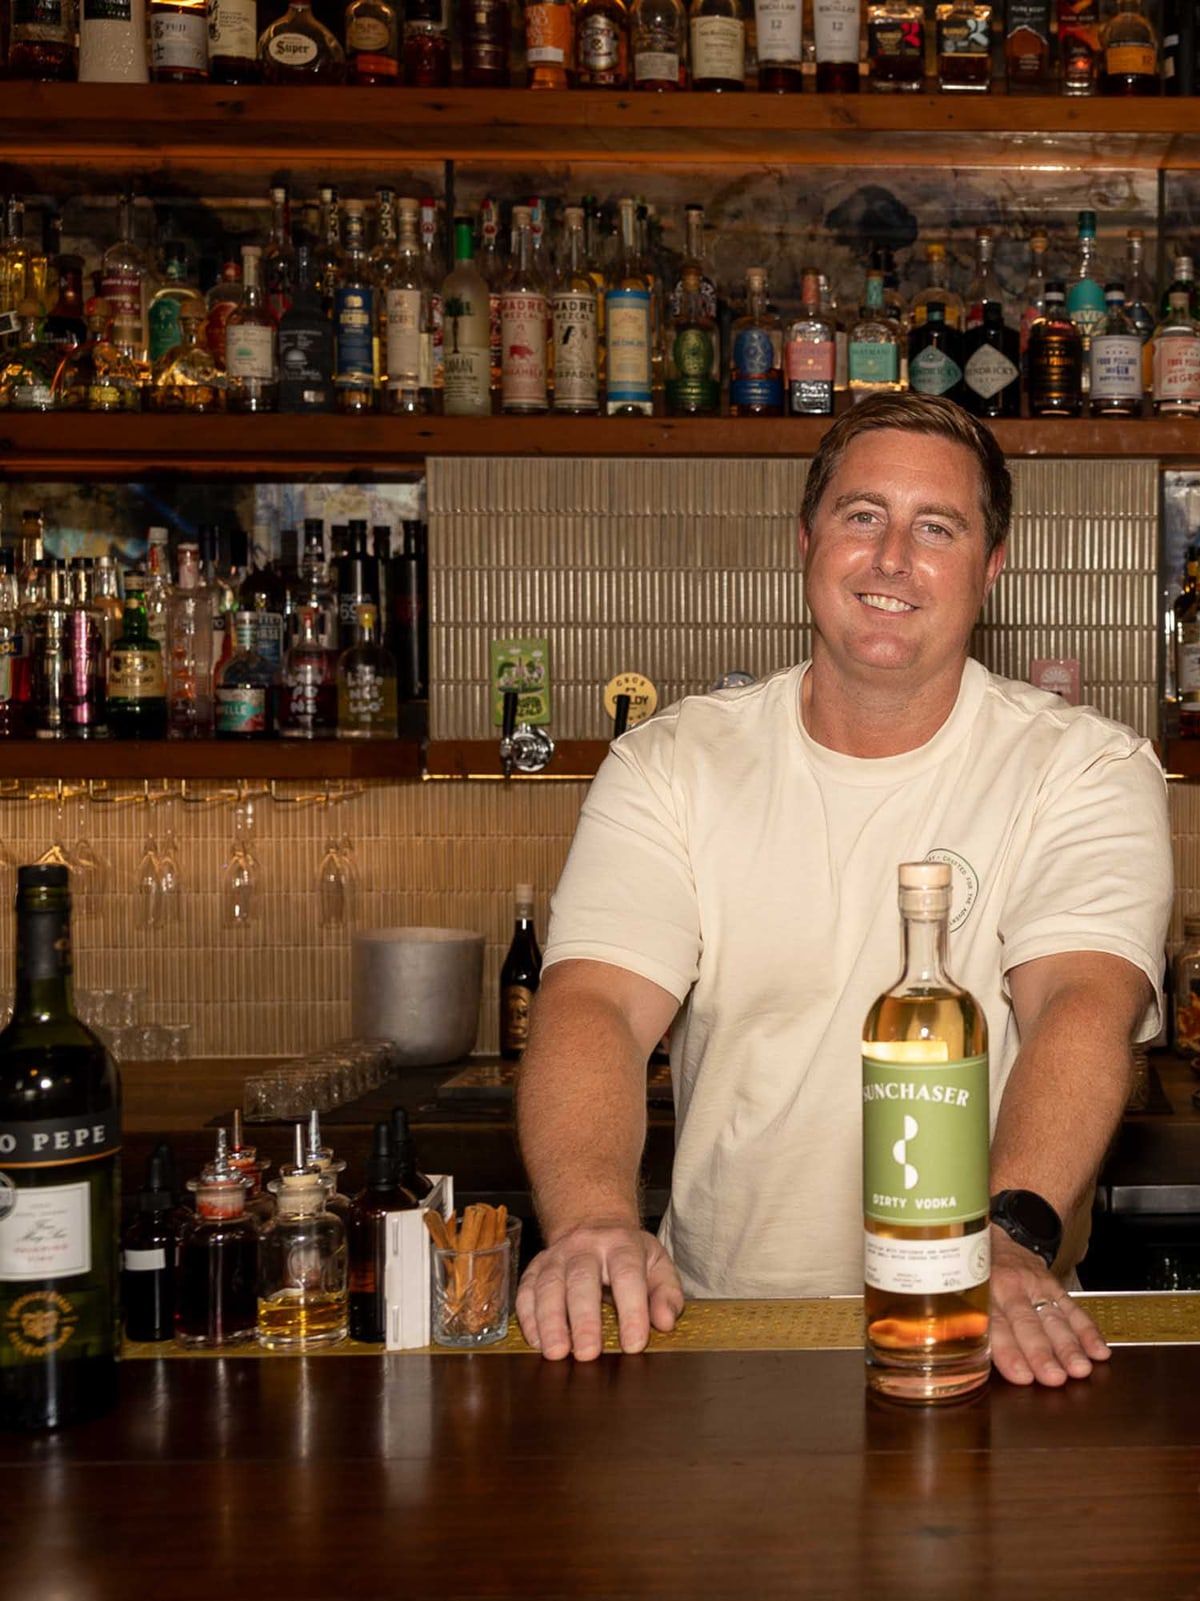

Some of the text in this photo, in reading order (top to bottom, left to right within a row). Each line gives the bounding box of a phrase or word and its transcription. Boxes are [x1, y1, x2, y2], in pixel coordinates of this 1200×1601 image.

[276, 40, 310, 55] Super
[554, 300, 596, 312] MADRE
[32, 1123, 107, 1153] PEPE
[872, 1193, 957, 1210] DIRTY VODKA
